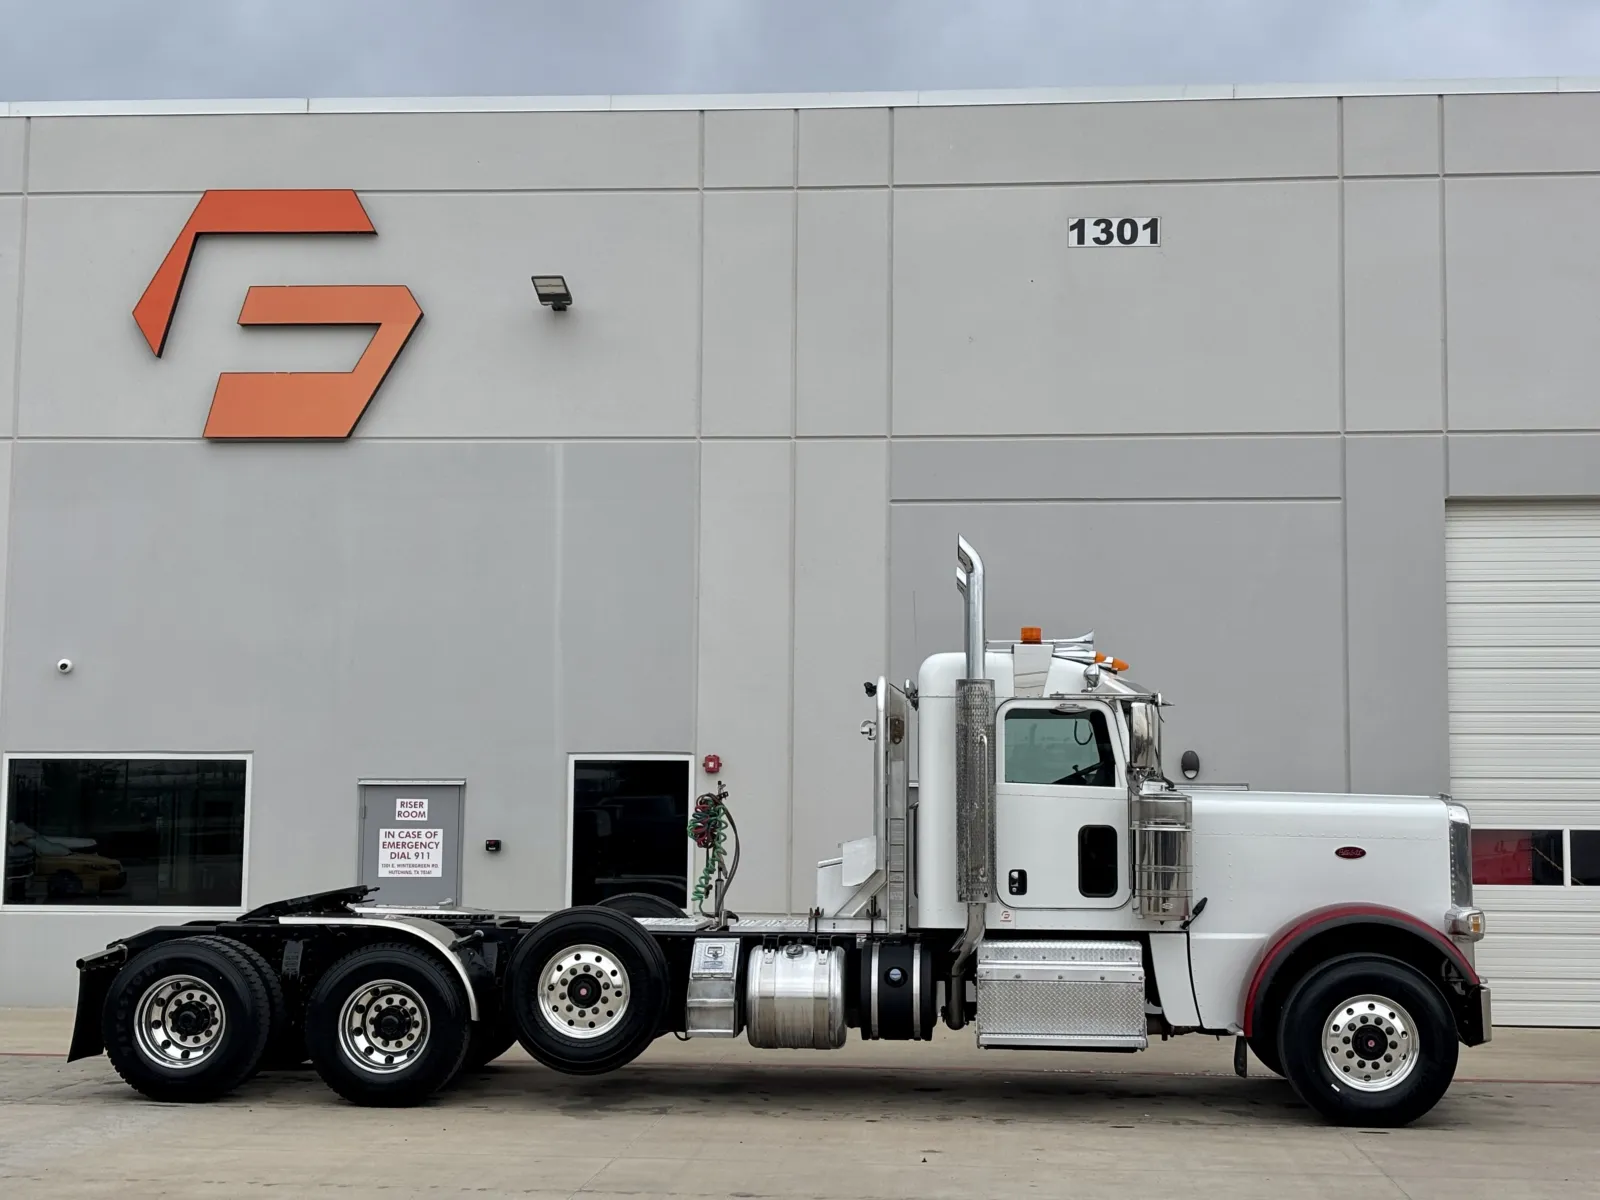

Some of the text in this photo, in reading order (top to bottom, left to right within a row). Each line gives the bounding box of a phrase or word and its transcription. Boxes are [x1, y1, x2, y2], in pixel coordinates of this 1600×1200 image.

[1069, 217, 1159, 245] 1301
[400, 801, 424, 809] RISER
[397, 810, 426, 818] ROOM
[384, 831, 439, 839] IN CASE OF
[382, 841, 440, 849] EMERGENCY
[390, 852, 430, 860] DIAL 911
